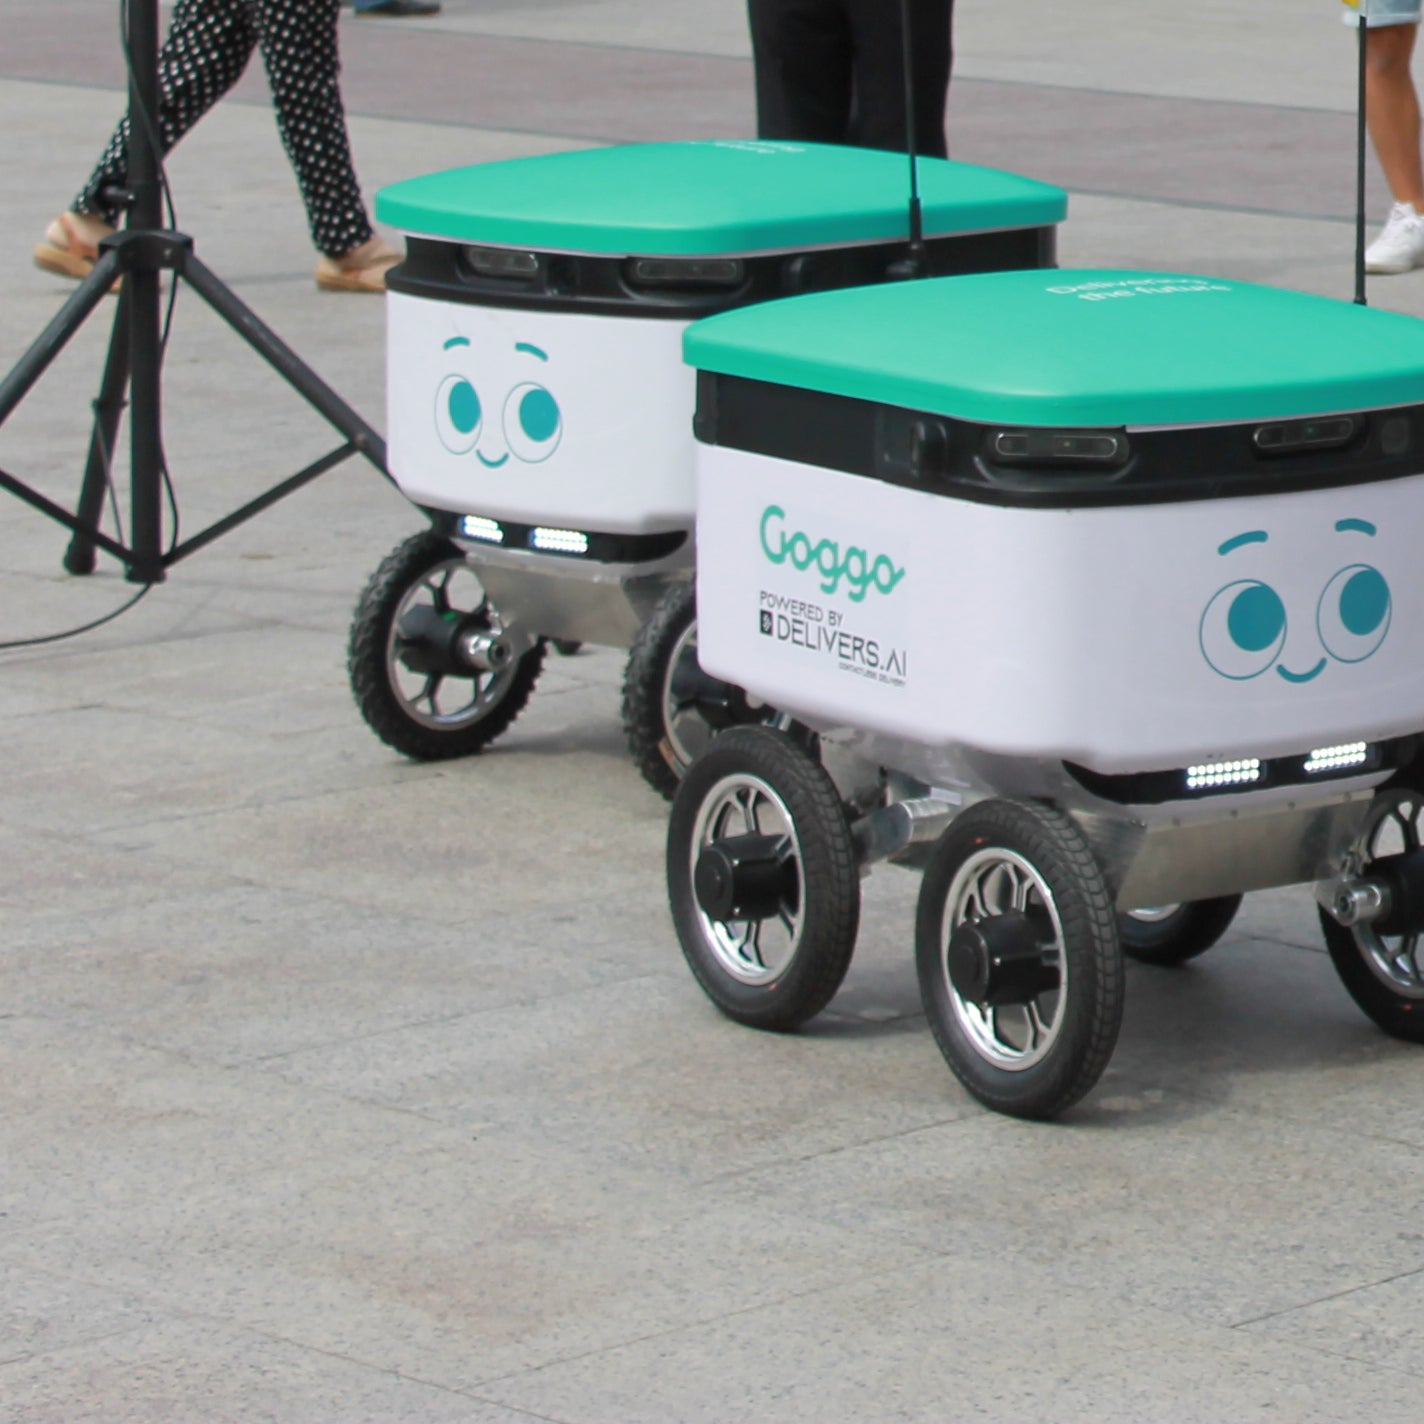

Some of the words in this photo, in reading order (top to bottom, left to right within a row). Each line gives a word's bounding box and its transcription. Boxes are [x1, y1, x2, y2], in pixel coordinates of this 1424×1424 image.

[760, 505, 906, 602] Goggo
[760, 590, 824, 622] POWERED
[828, 610, 843, 627] BY
[777, 614, 907, 677] DELIVERS.AI
